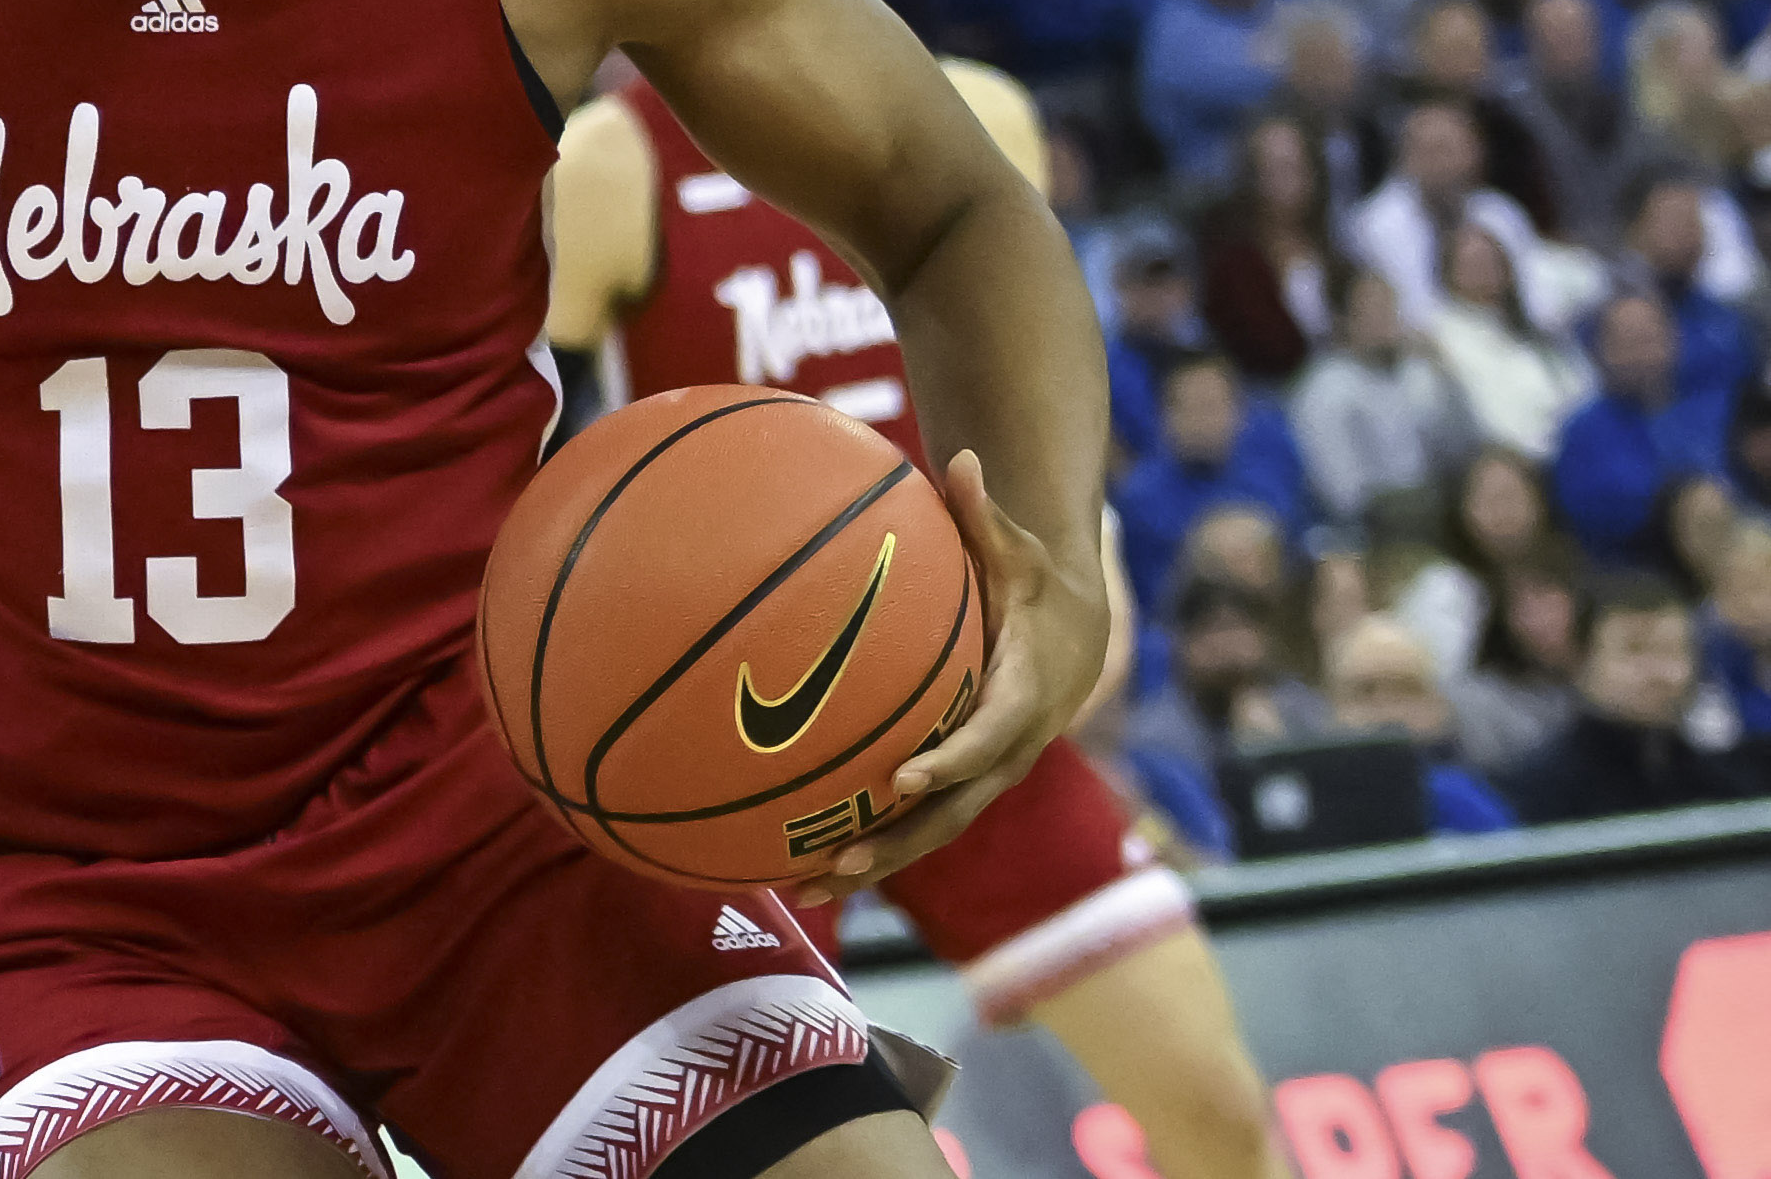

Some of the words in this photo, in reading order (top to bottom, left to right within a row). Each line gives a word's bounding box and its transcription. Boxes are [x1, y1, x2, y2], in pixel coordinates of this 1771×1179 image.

[130, 11, 220, 33] adidas
[40, 349, 295, 644] 13
[711, 932, 781, 951] adidas
